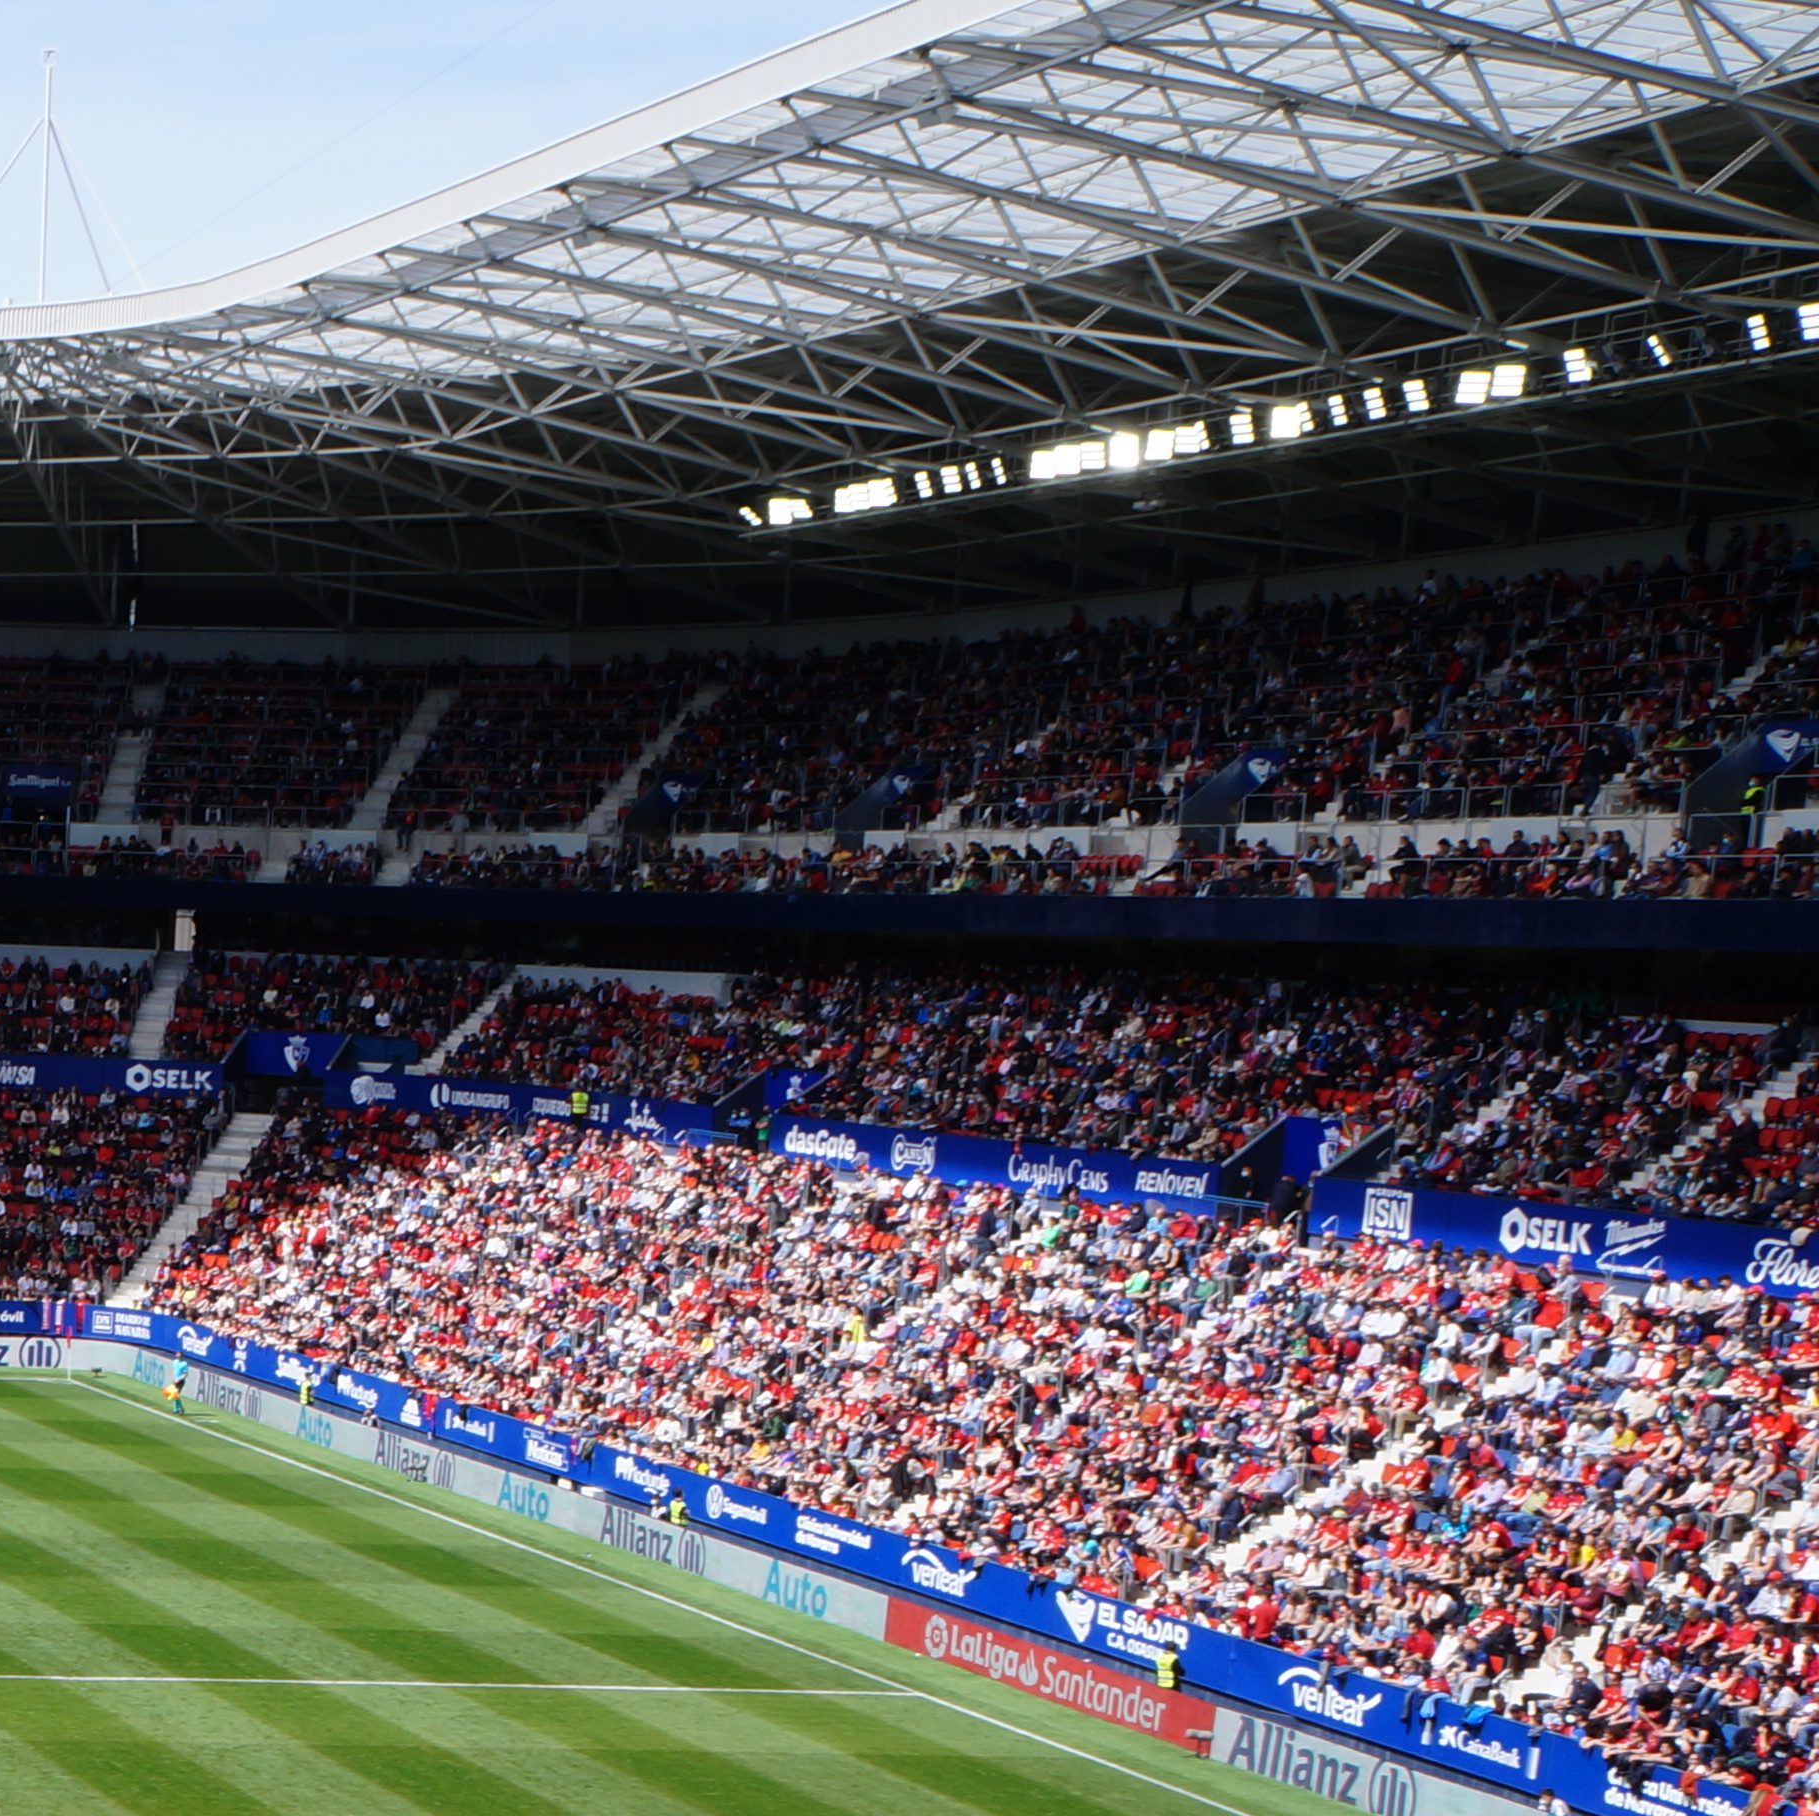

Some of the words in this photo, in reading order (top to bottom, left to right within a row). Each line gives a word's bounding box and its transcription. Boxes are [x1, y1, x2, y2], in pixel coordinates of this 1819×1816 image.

[151, 1068, 214, 1091] SELK
[784, 1124, 857, 1161] dasGate
[1368, 1196, 1406, 1230] ISN
[1525, 1216, 1594, 1256] SELK
[132, 1349, 164, 1387] Auto
[196, 1370, 244, 1416] Allianz
[296, 1405, 332, 1449] Auto
[497, 1470, 550, 1522] Auto
[600, 1504, 674, 1566] Allianz
[763, 1559, 828, 1618] Auto
[1096, 1602, 1121, 1630] EL
[1121, 1608, 1189, 1651] SADAR
[950, 1623, 1019, 1681] LaLiga
[1039, 1655, 1167, 1733] Santander
[1227, 1715, 1360, 1807] Allianz
[1457, 1730, 1521, 1769] CaixaBank
[1604, 1785, 1624, 1807] de
